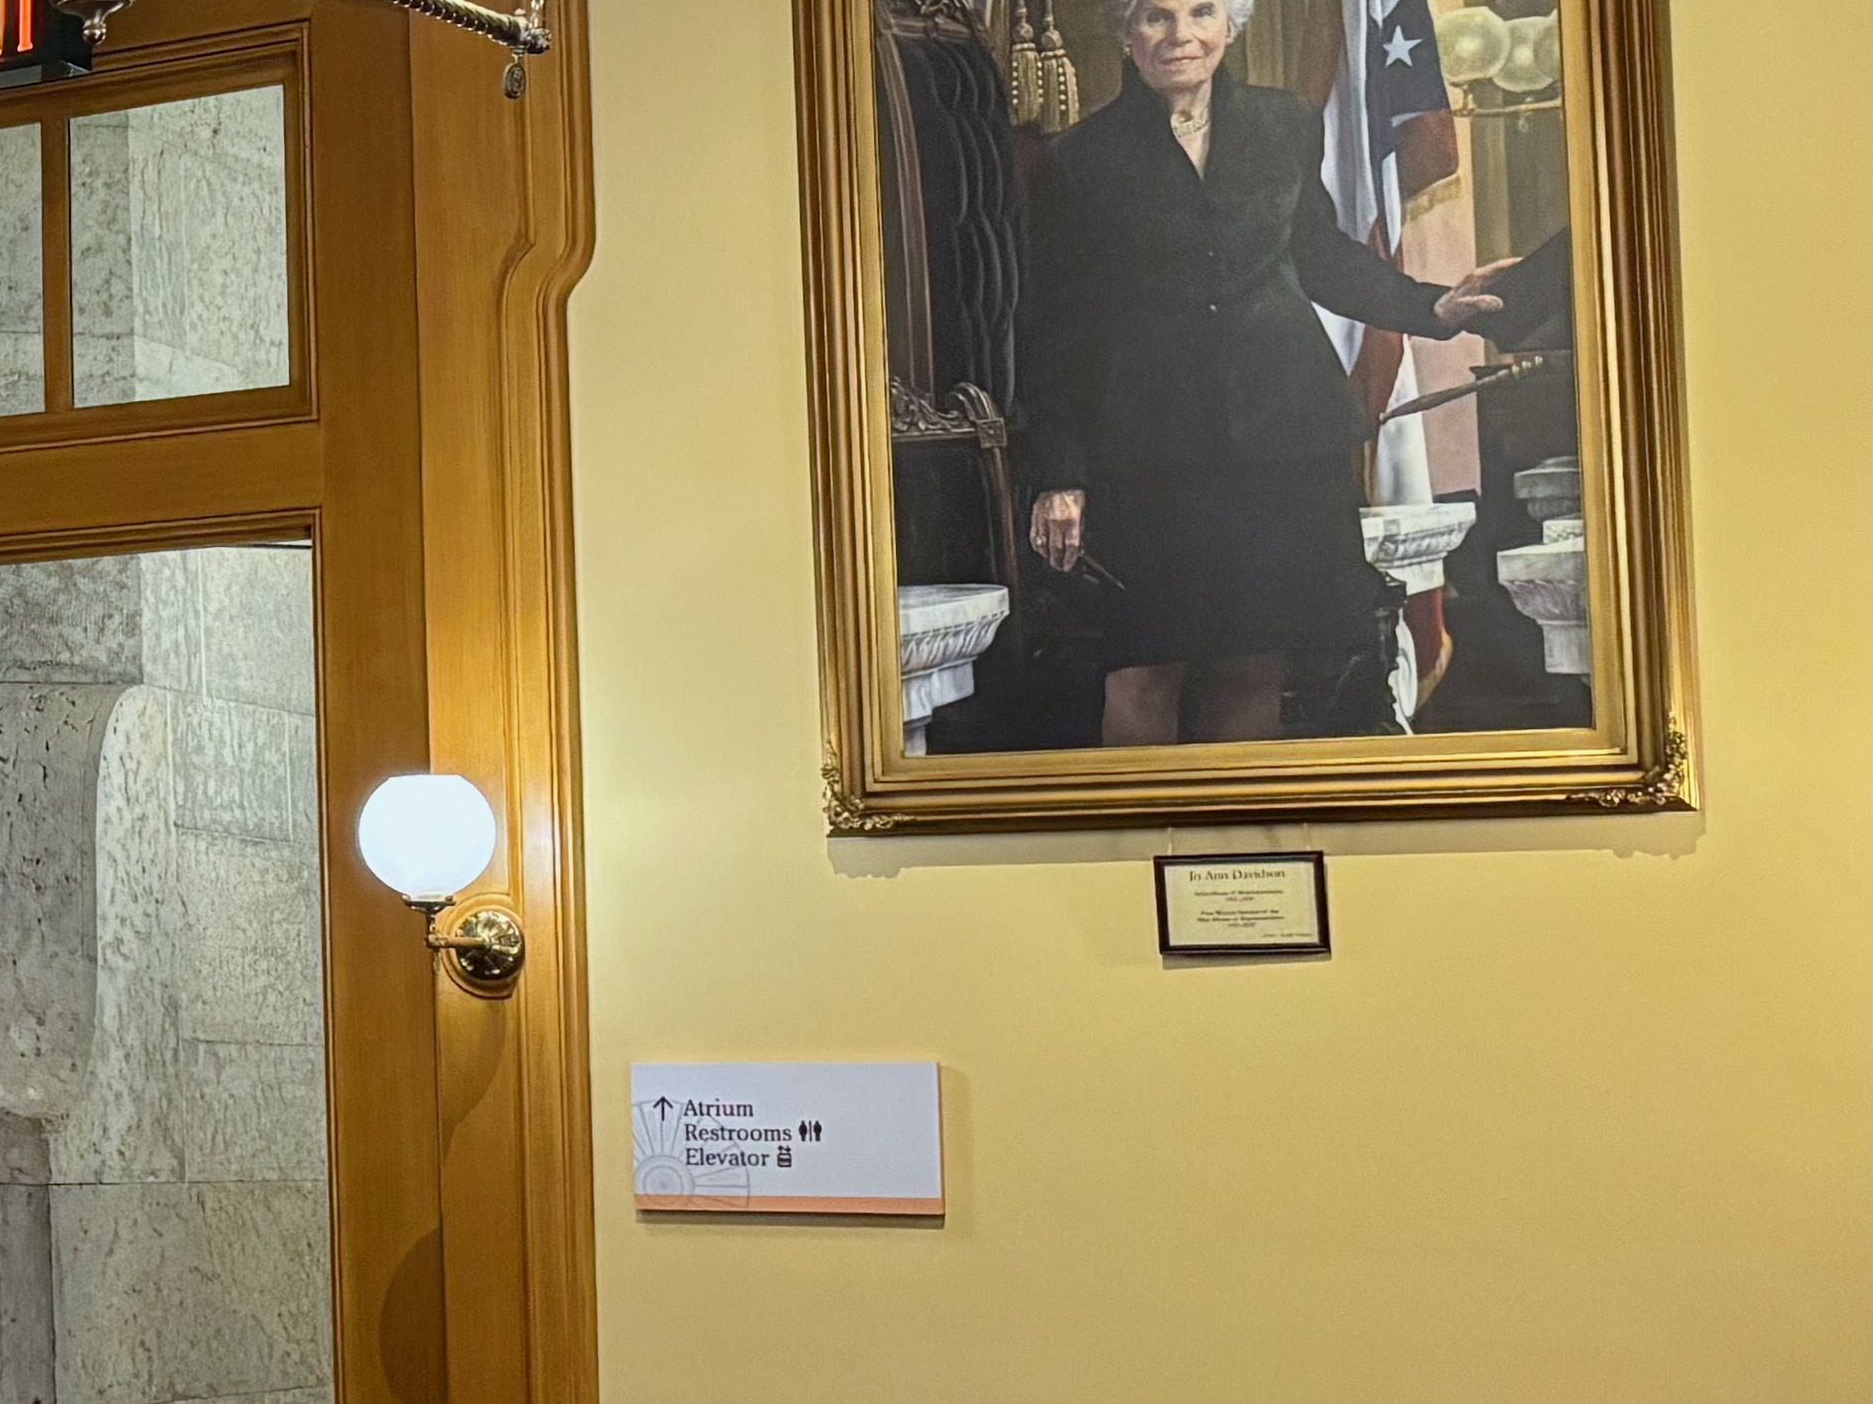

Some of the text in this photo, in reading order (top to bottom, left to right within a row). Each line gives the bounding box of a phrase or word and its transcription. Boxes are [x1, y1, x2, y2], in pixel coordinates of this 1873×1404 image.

[1205, 870, 1229, 881] Ann
[1232, 869, 1285, 880] Davidson
[684, 1098, 753, 1117] Atrium
[685, 1123, 792, 1141] Restrooms
[685, 1147, 770, 1167] Elevator
